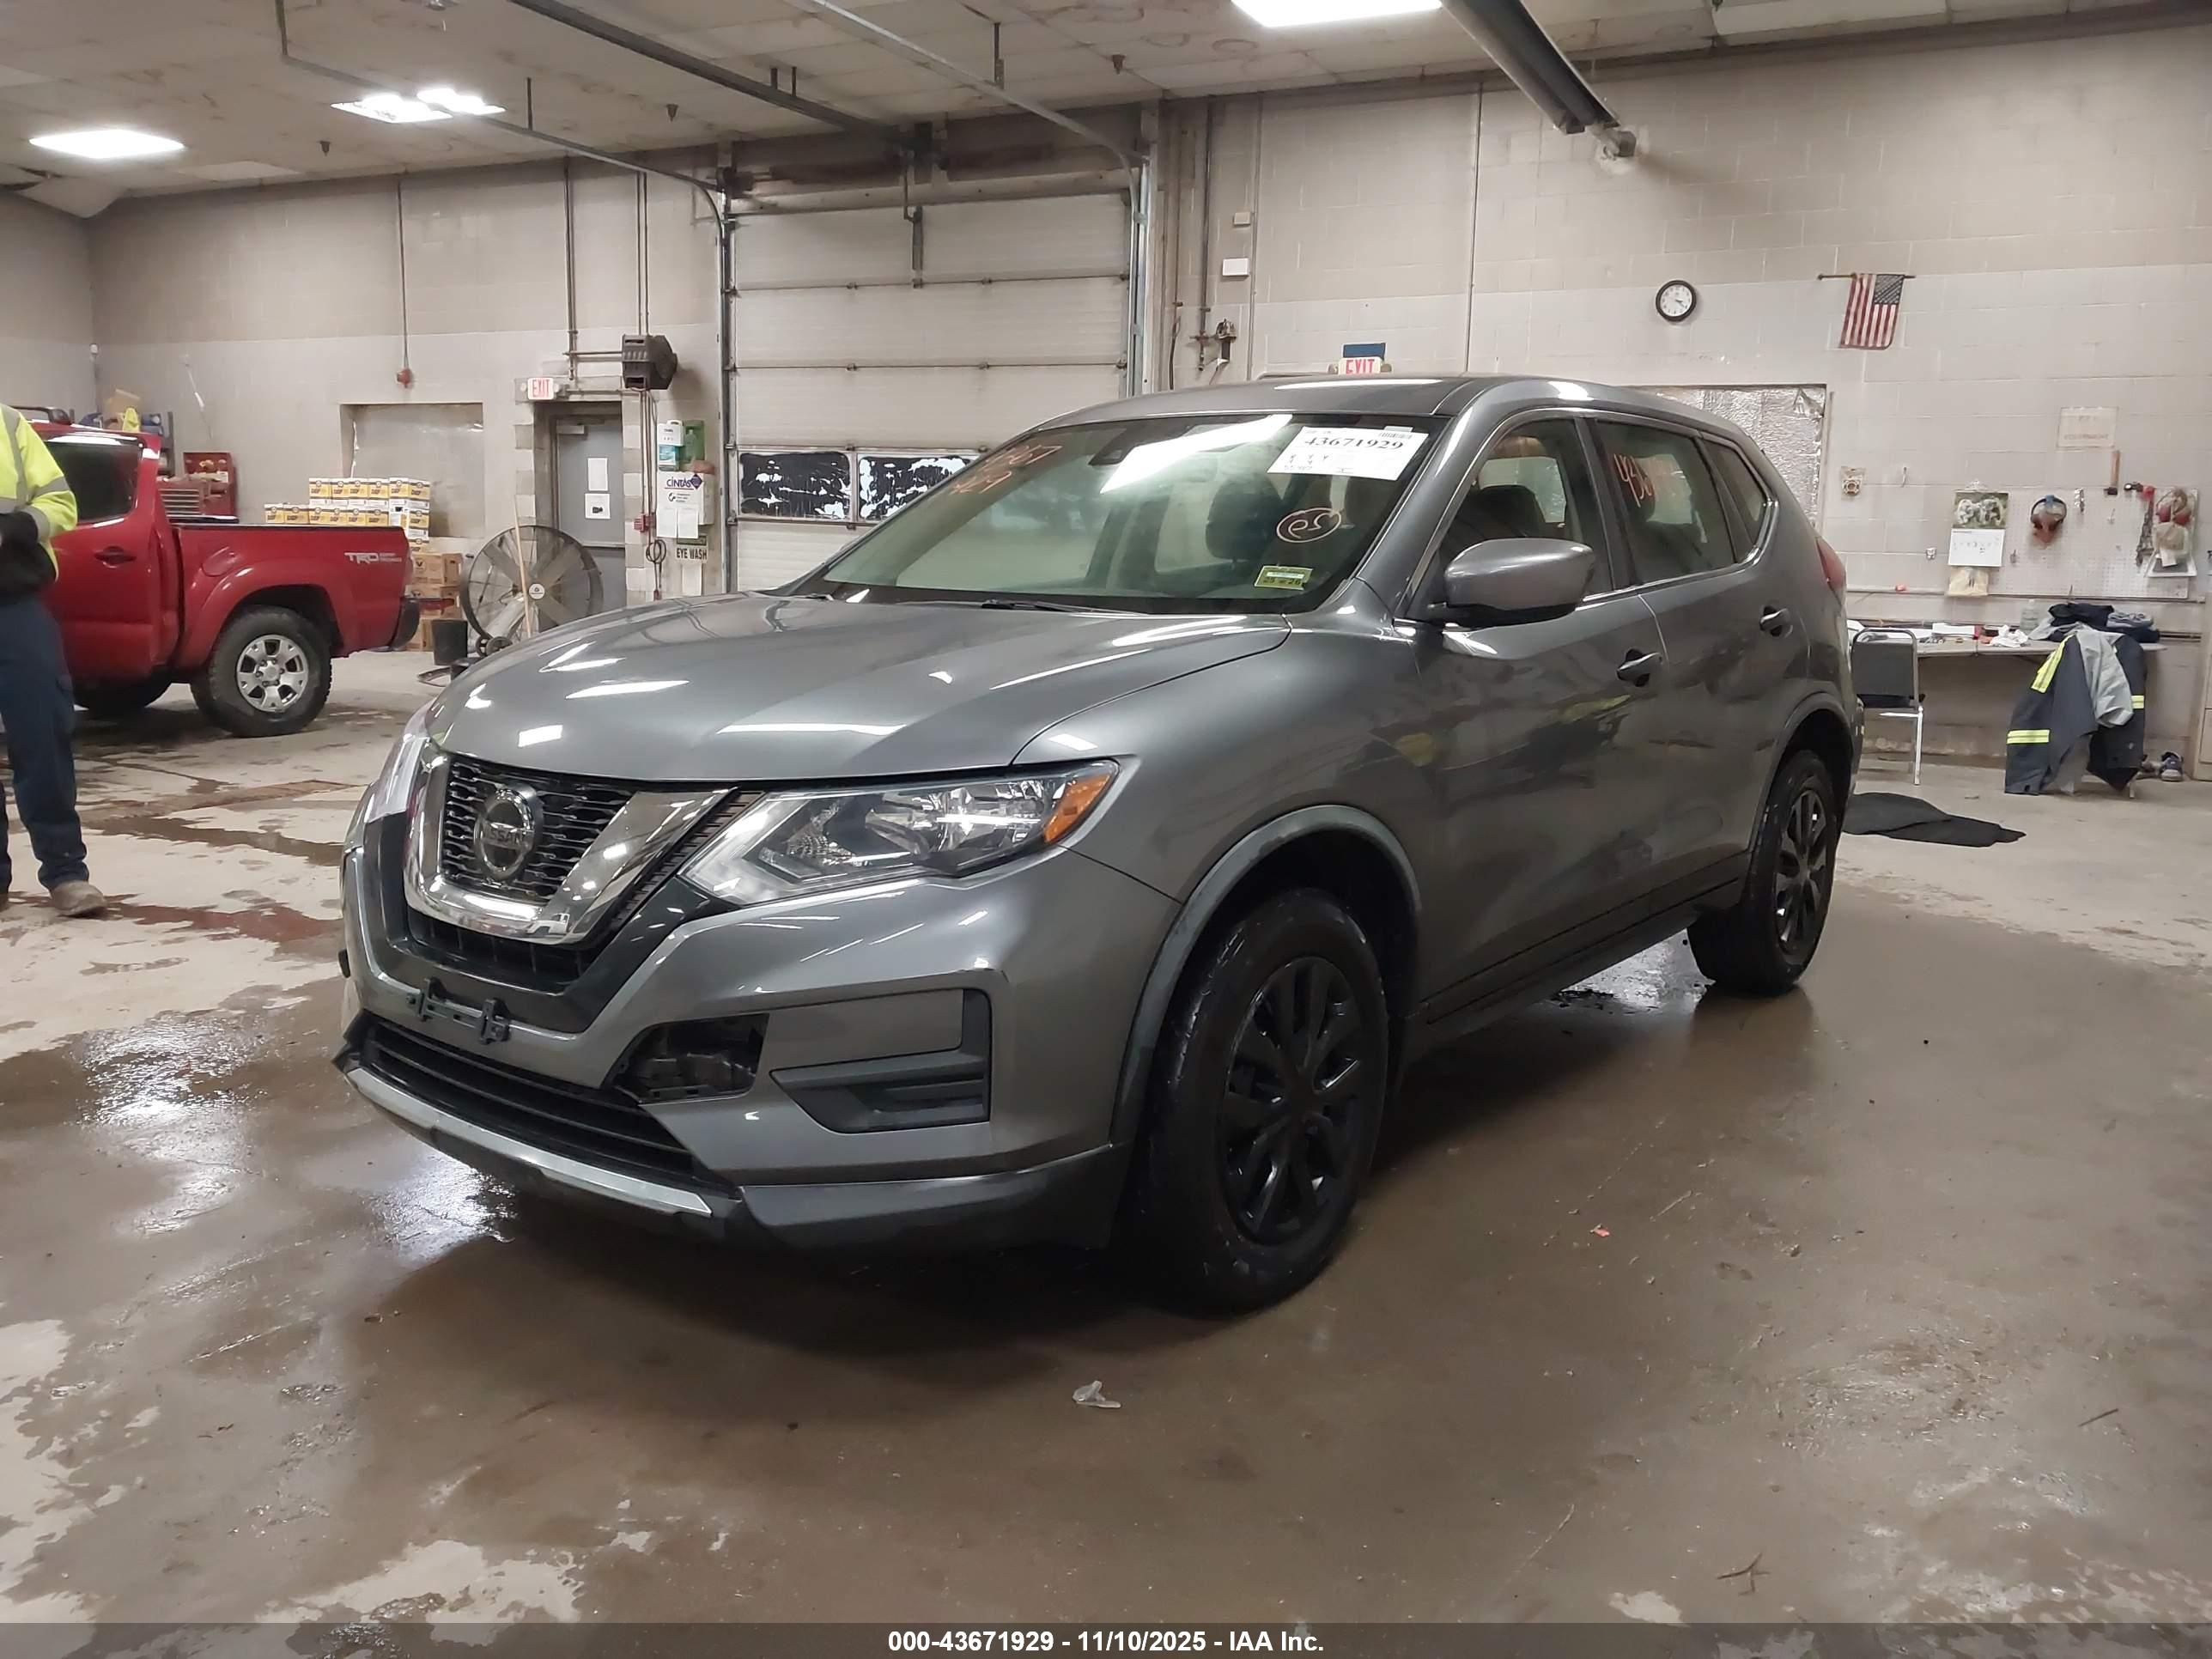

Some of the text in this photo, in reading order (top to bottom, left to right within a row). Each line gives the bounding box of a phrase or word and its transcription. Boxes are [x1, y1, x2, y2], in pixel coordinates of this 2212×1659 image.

[532, 379, 550, 398] EXIT
[1304, 436, 1404, 450] 43671929
[344, 552, 379, 564] TRD
[677, 548, 708, 560] EYE WASH
